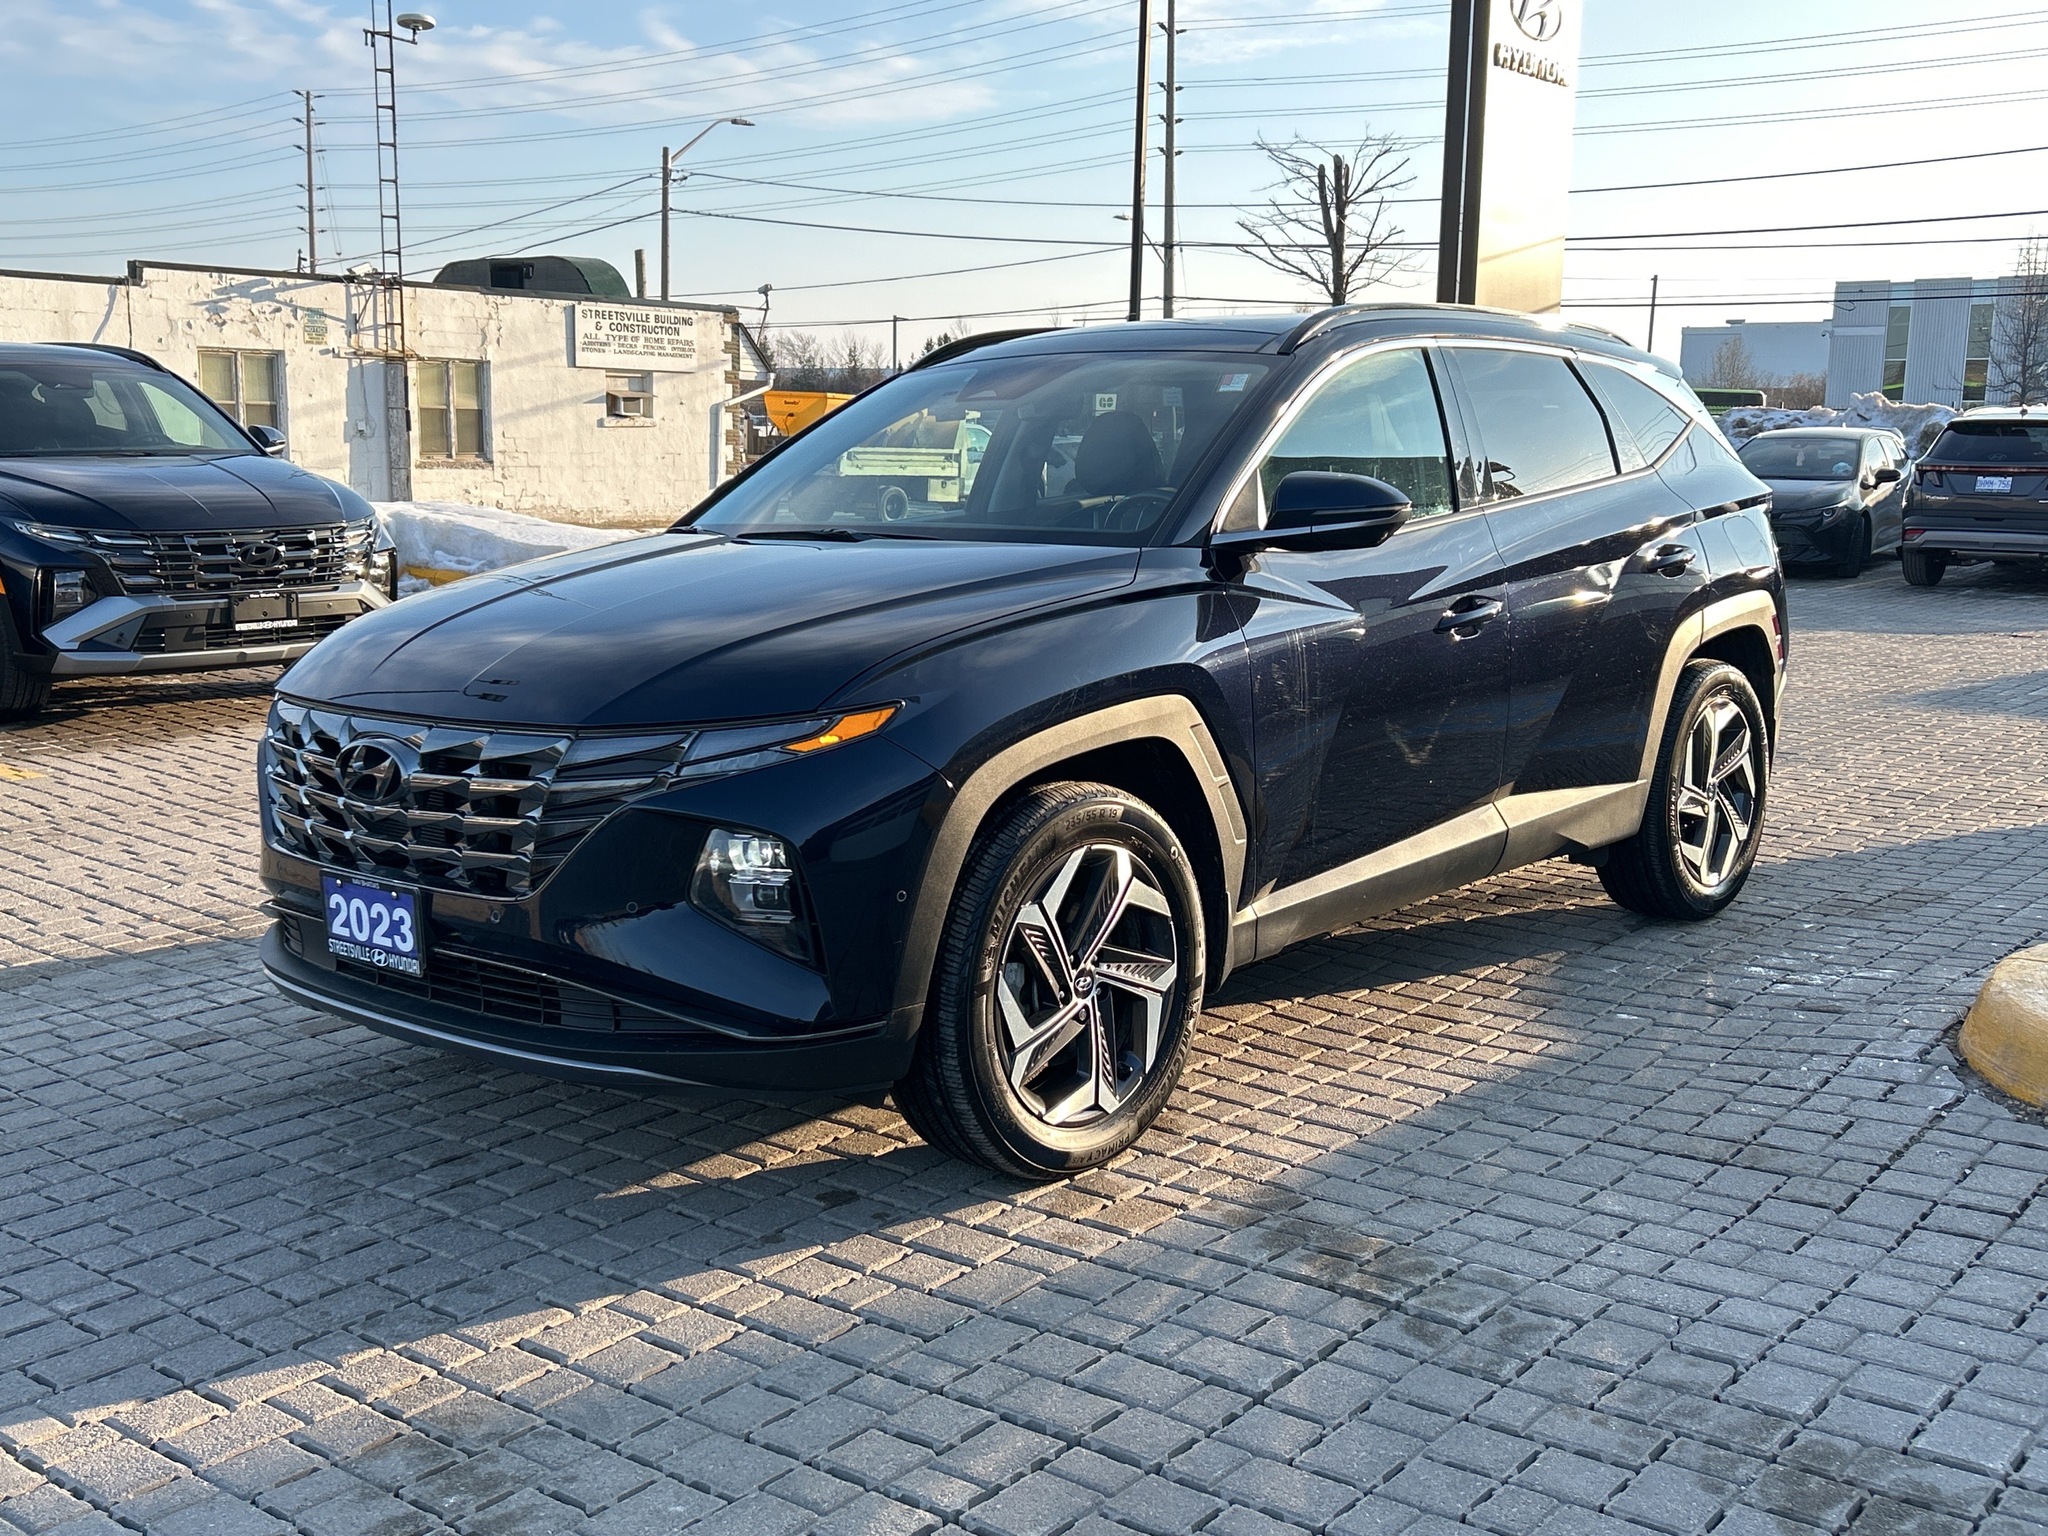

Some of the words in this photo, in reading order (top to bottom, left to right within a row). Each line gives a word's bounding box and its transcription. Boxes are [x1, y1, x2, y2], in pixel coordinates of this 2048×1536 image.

[581, 309, 651, 323] STREETSVILLE
[654, 314, 694, 326] BUILDING
[595, 321, 603, 331] &
[609, 322, 680, 336] CONSTRUCTION
[605, 334, 629, 342] TYPE
[631, 335, 641, 343] OF
[644, 336, 665, 345] HOME
[667, 338, 695, 347] REPAIRS
[613, 349, 656, 357] LANDSCAPING
[1065, 810, 1097, 831] 235/55
[1099, 809, 1106, 820] R
[1108, 807, 1118, 818] 19
[329, 893, 414, 952] 2023
[328, 938, 371, 962] STREETSVILLE
[388, 953, 421, 975] HYUNDAI
[1087, 1133, 1130, 1163] PRIMACY
